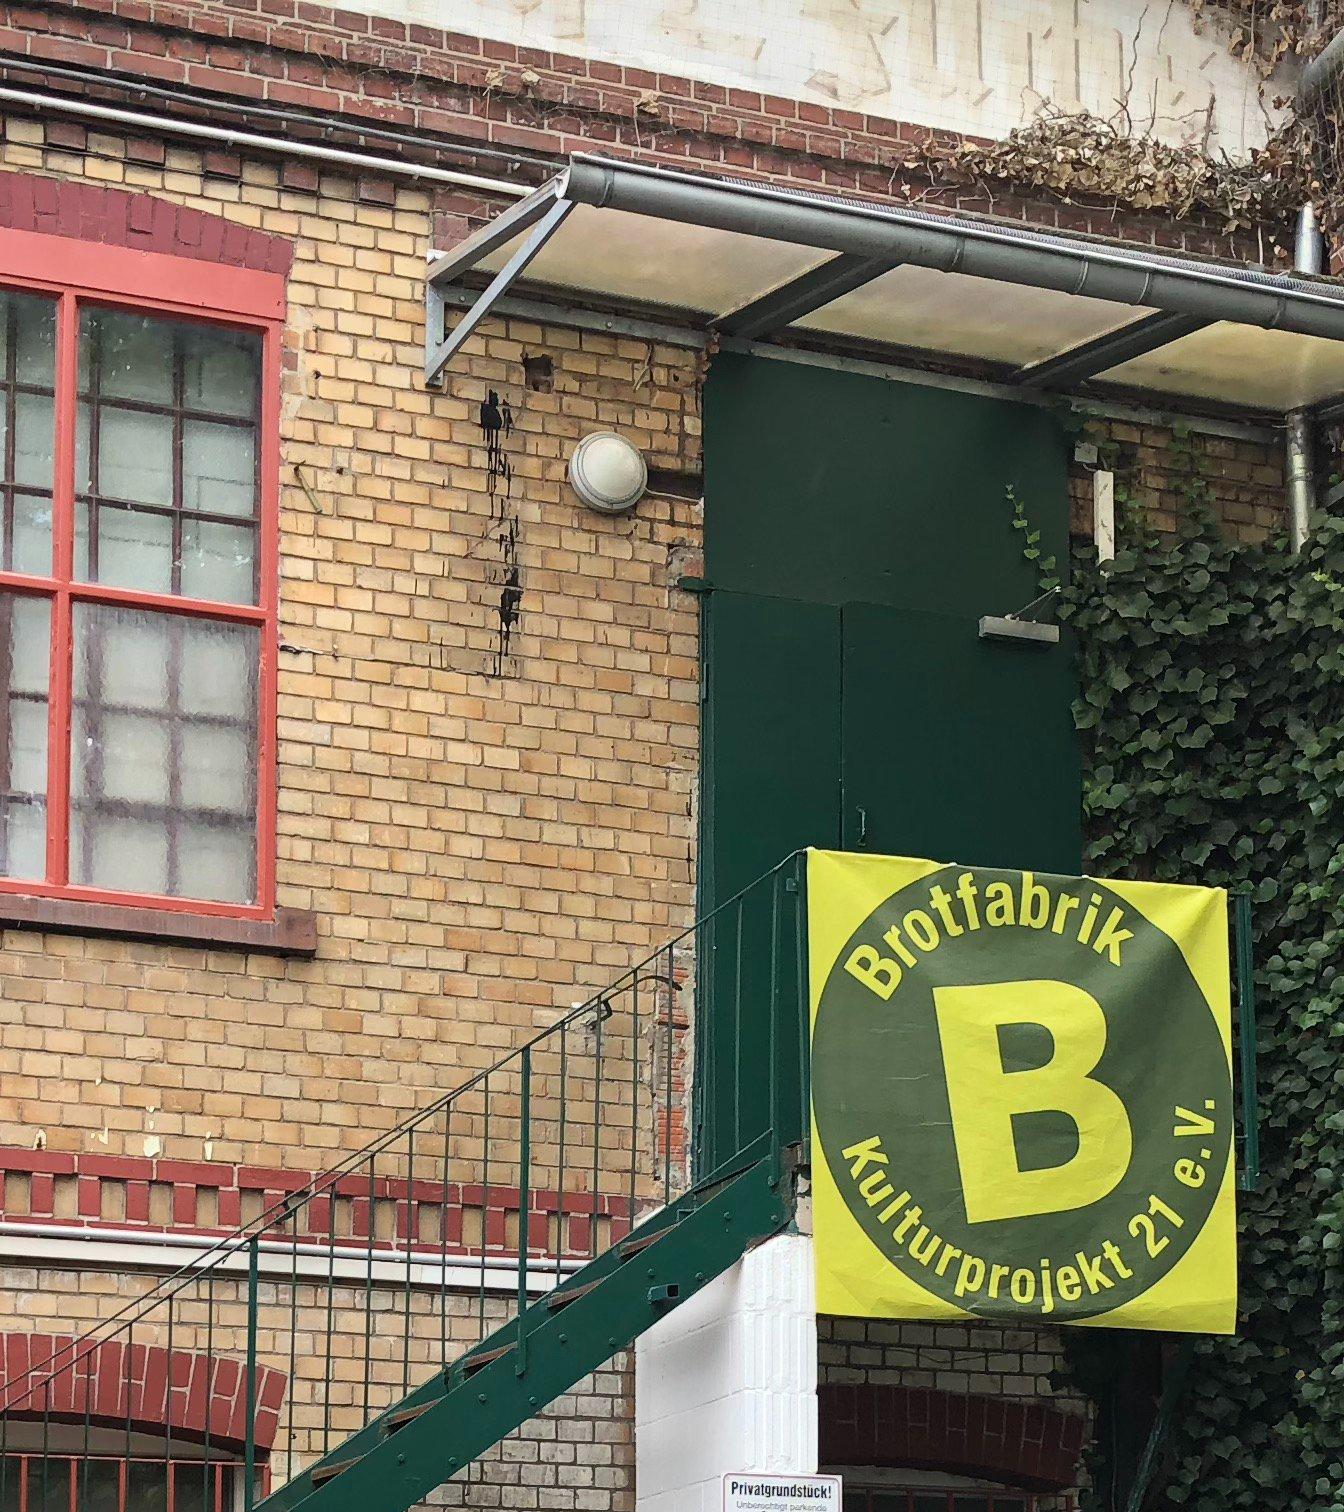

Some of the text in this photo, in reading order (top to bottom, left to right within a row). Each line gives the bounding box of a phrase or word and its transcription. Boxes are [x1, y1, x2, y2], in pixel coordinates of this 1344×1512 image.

[843, 869, 1136, 1001] Brotfabrik
[932, 978, 1134, 1225] B
[841, 1096, 1218, 1314] Kulturprojekt 21 e.V.
[731, 1481, 832, 1499] Privatgrundstück!
